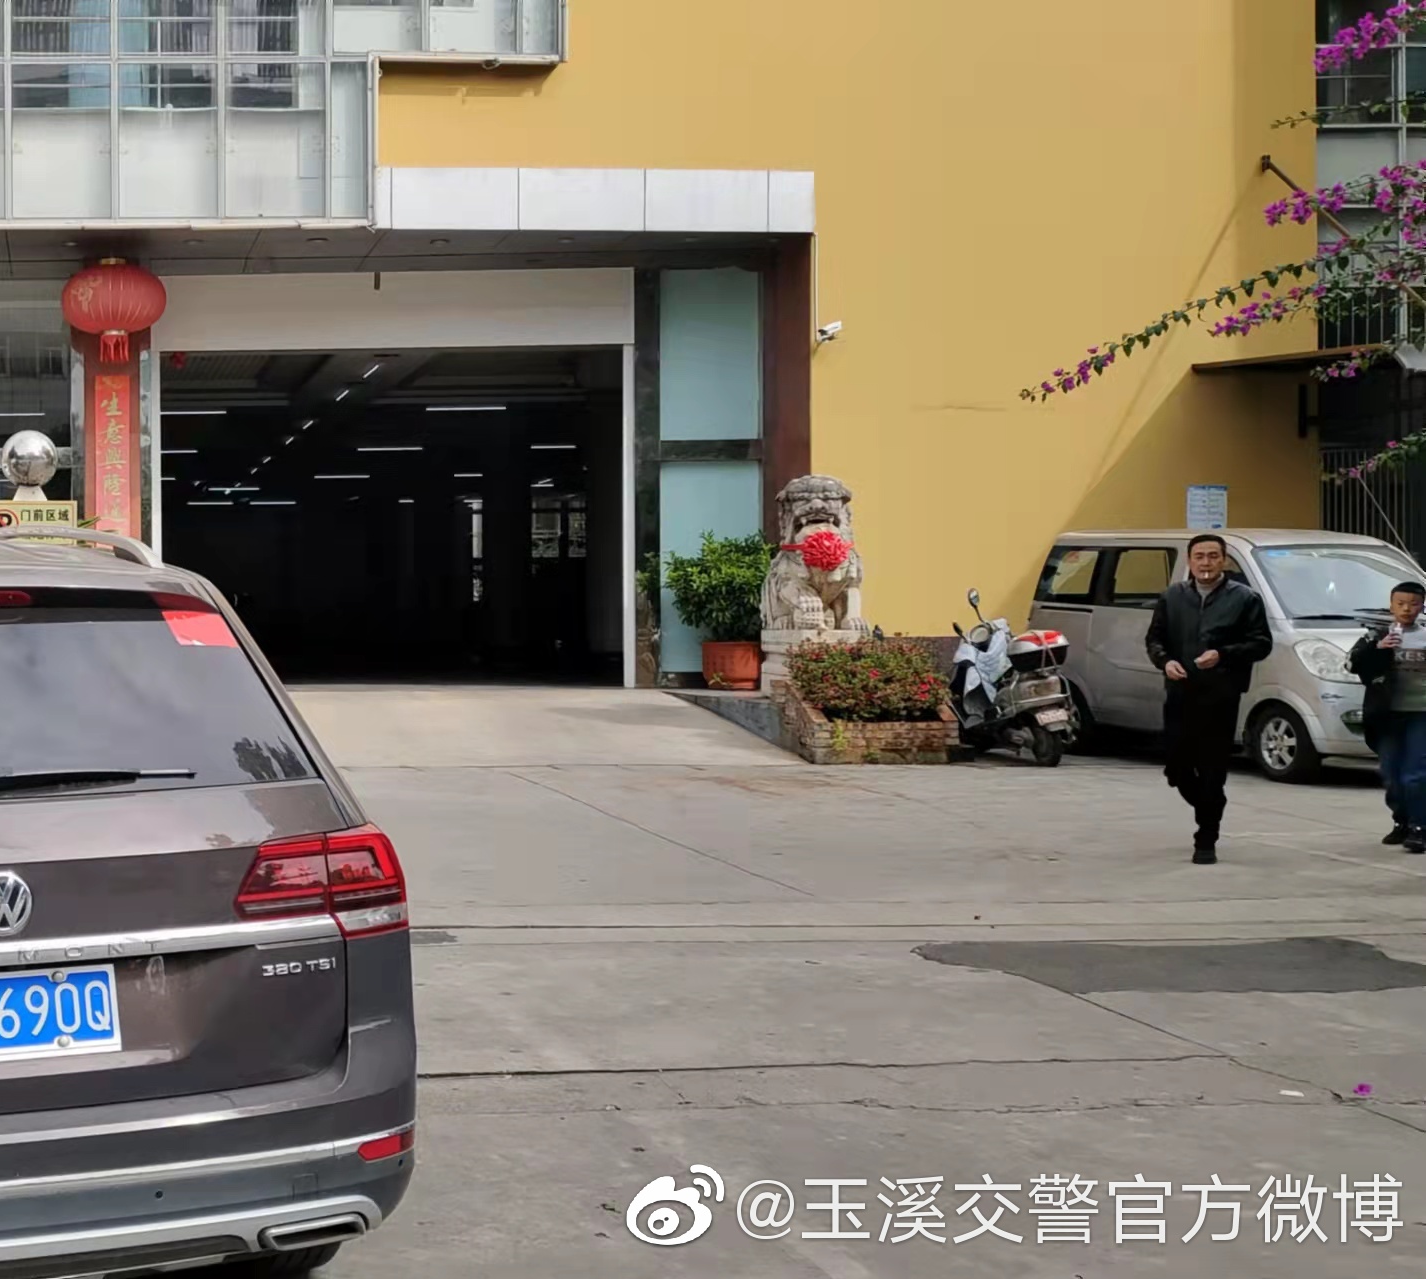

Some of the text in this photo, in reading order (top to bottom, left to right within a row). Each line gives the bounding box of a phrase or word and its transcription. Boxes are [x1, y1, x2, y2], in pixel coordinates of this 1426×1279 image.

[20, 508, 70, 521] 门前区域
[261, 961, 302, 977] 380
